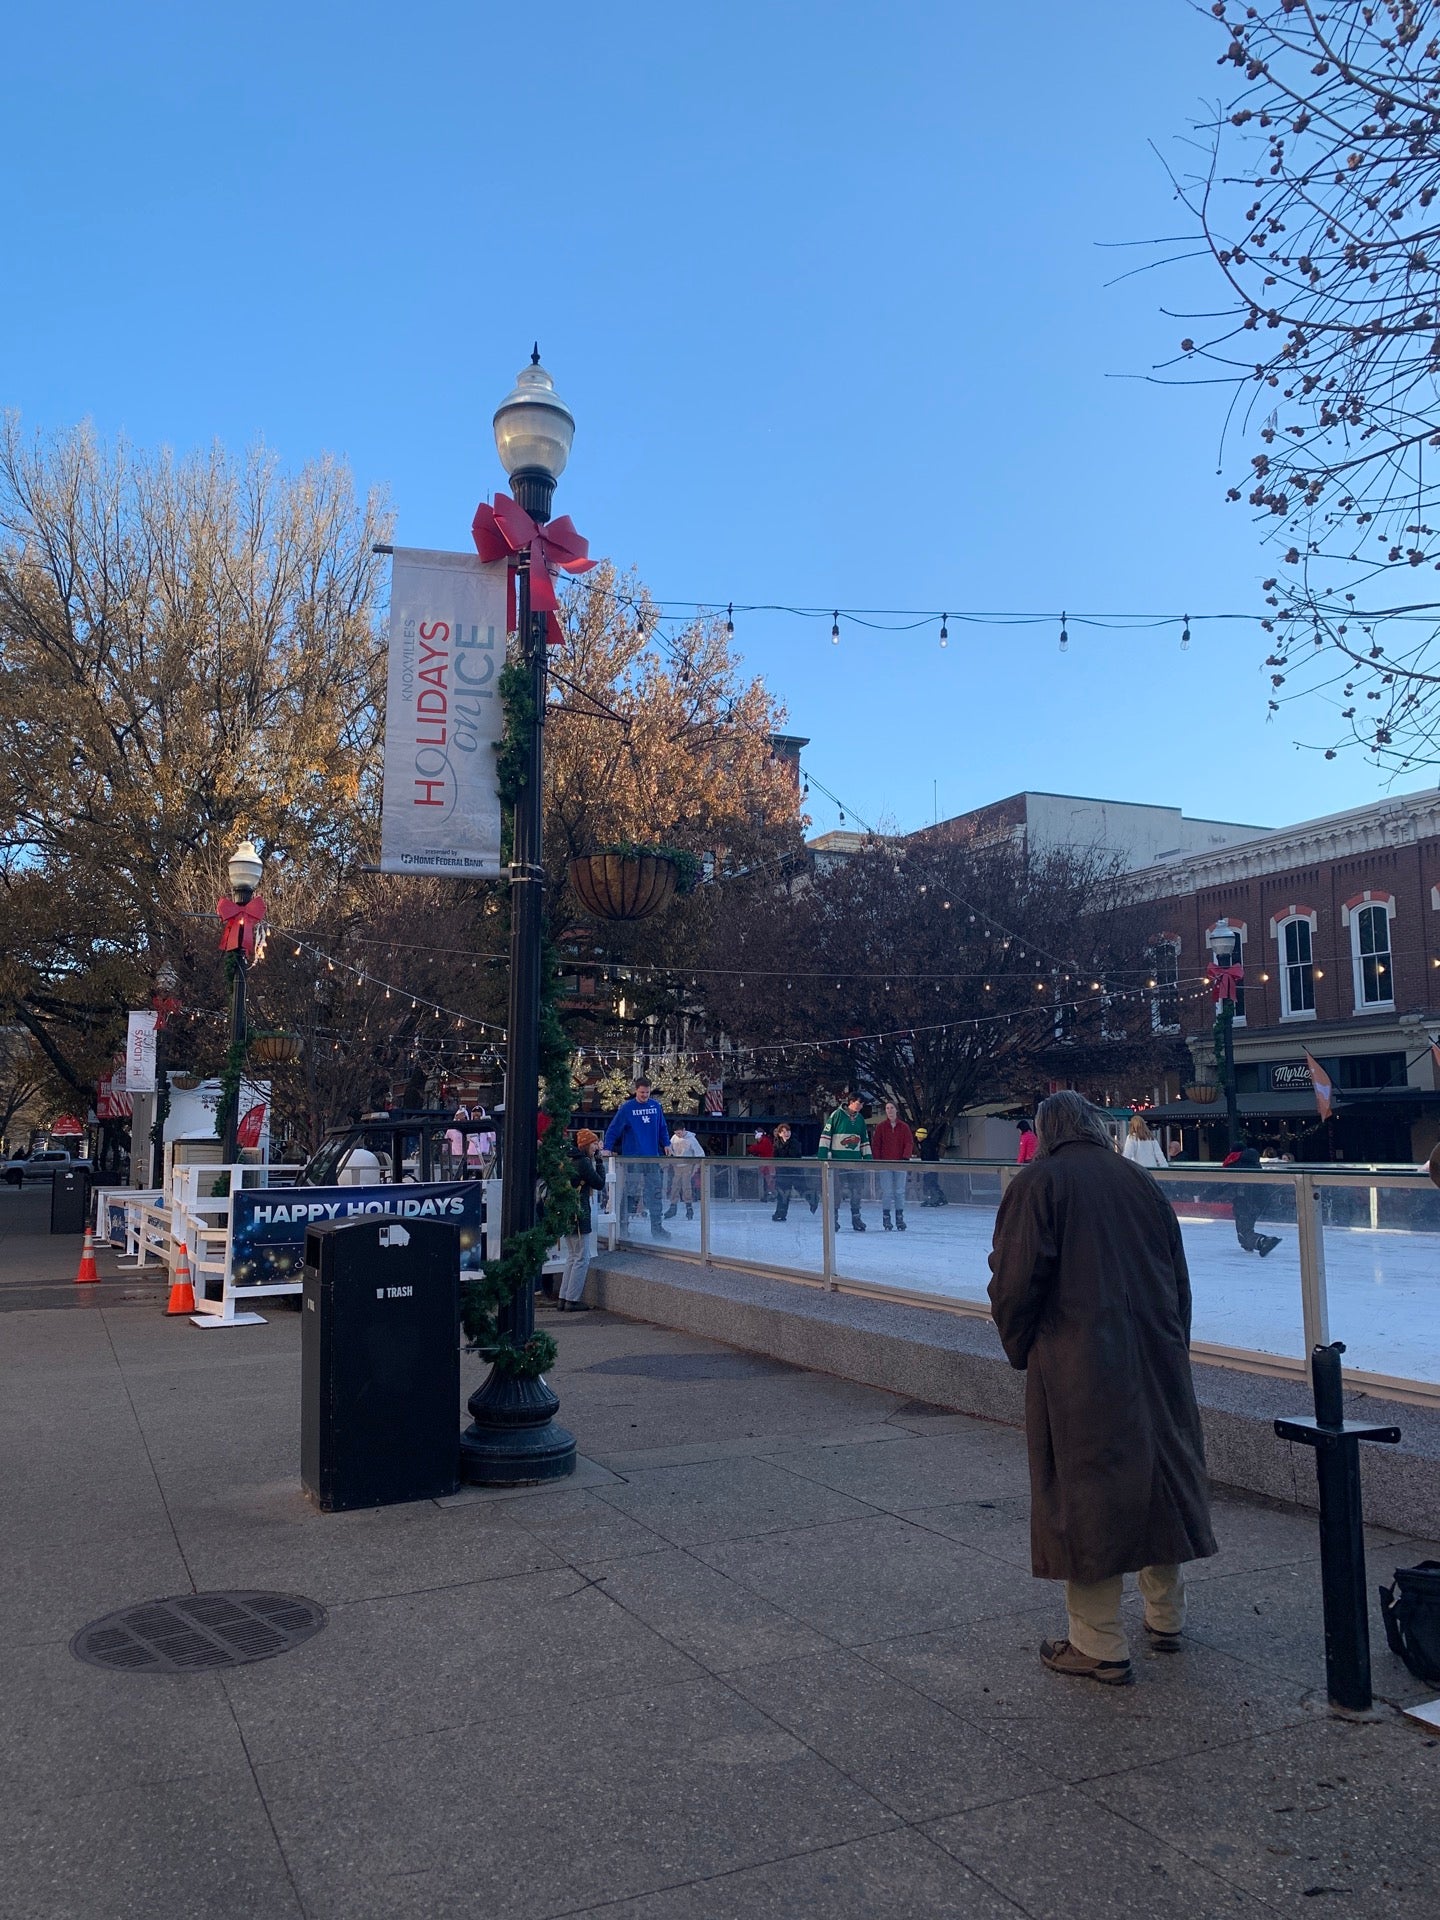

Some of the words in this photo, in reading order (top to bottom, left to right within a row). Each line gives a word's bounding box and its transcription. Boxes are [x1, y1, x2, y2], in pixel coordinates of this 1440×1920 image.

[402, 618, 415, 702] KNOXVILLE'S
[454, 623, 495, 699] ICE
[413, 621, 456, 821] HOLIDAYS
[453, 699, 481, 753] on
[413, 855, 435, 865] HOME
[435, 856, 464, 867] FEDERAL
[464, 857, 484, 867] BANK
[133, 1029, 144, 1076] HOLIDAYS
[1274, 1066, 1312, 1082] Myrtle
[632, 1108, 657, 1116] KENTUCKY
[253, 1202, 341, 1224] HAPPY
[346, 1197, 465, 1217] HOLIDAYS
[386, 1286, 413, 1298] TRASH
